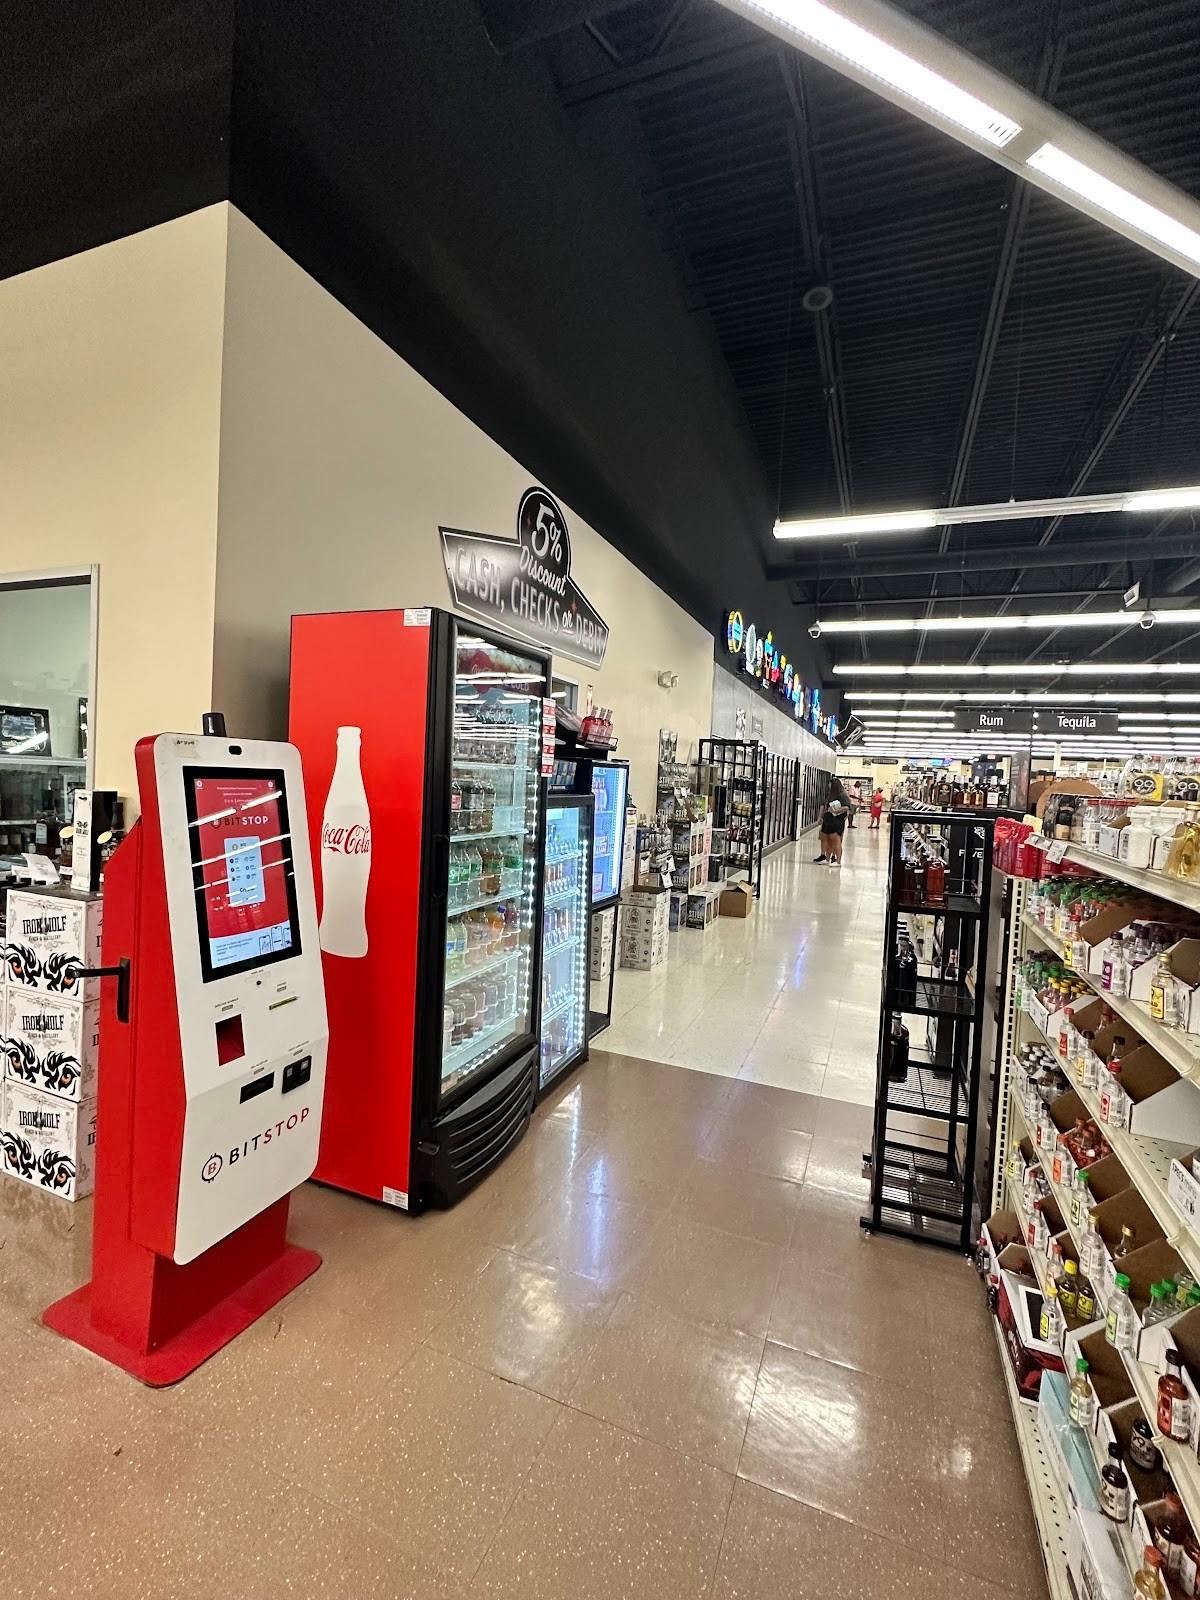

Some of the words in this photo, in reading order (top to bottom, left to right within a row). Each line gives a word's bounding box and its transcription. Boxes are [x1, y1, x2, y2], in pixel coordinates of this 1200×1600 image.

[531, 503, 562, 562] 5%
[520, 545, 566, 597] Discount
[455, 546, 505, 613] CASH,
[511, 576, 560, 633] CHECKS
[562, 610, 574, 630] or
[575, 614, 606, 656] DEBIT
[979, 714, 1004, 726] Rum
[1057, 715, 1097, 729] Tequila
[224, 815, 269, 826] BITSTOP
[322, 822, 370, 855] Coca-Cola
[22, 917, 42, 934] IRON
[44, 915, 66, 933] WOLF
[21, 1015, 40, 1031] IRON
[42, 1014, 64, 1031] WOLF
[18, 1110, 37, 1127] IRON
[39, 1112, 60, 1129] WOLF
[229, 1106, 310, 1166] BITSTOP
